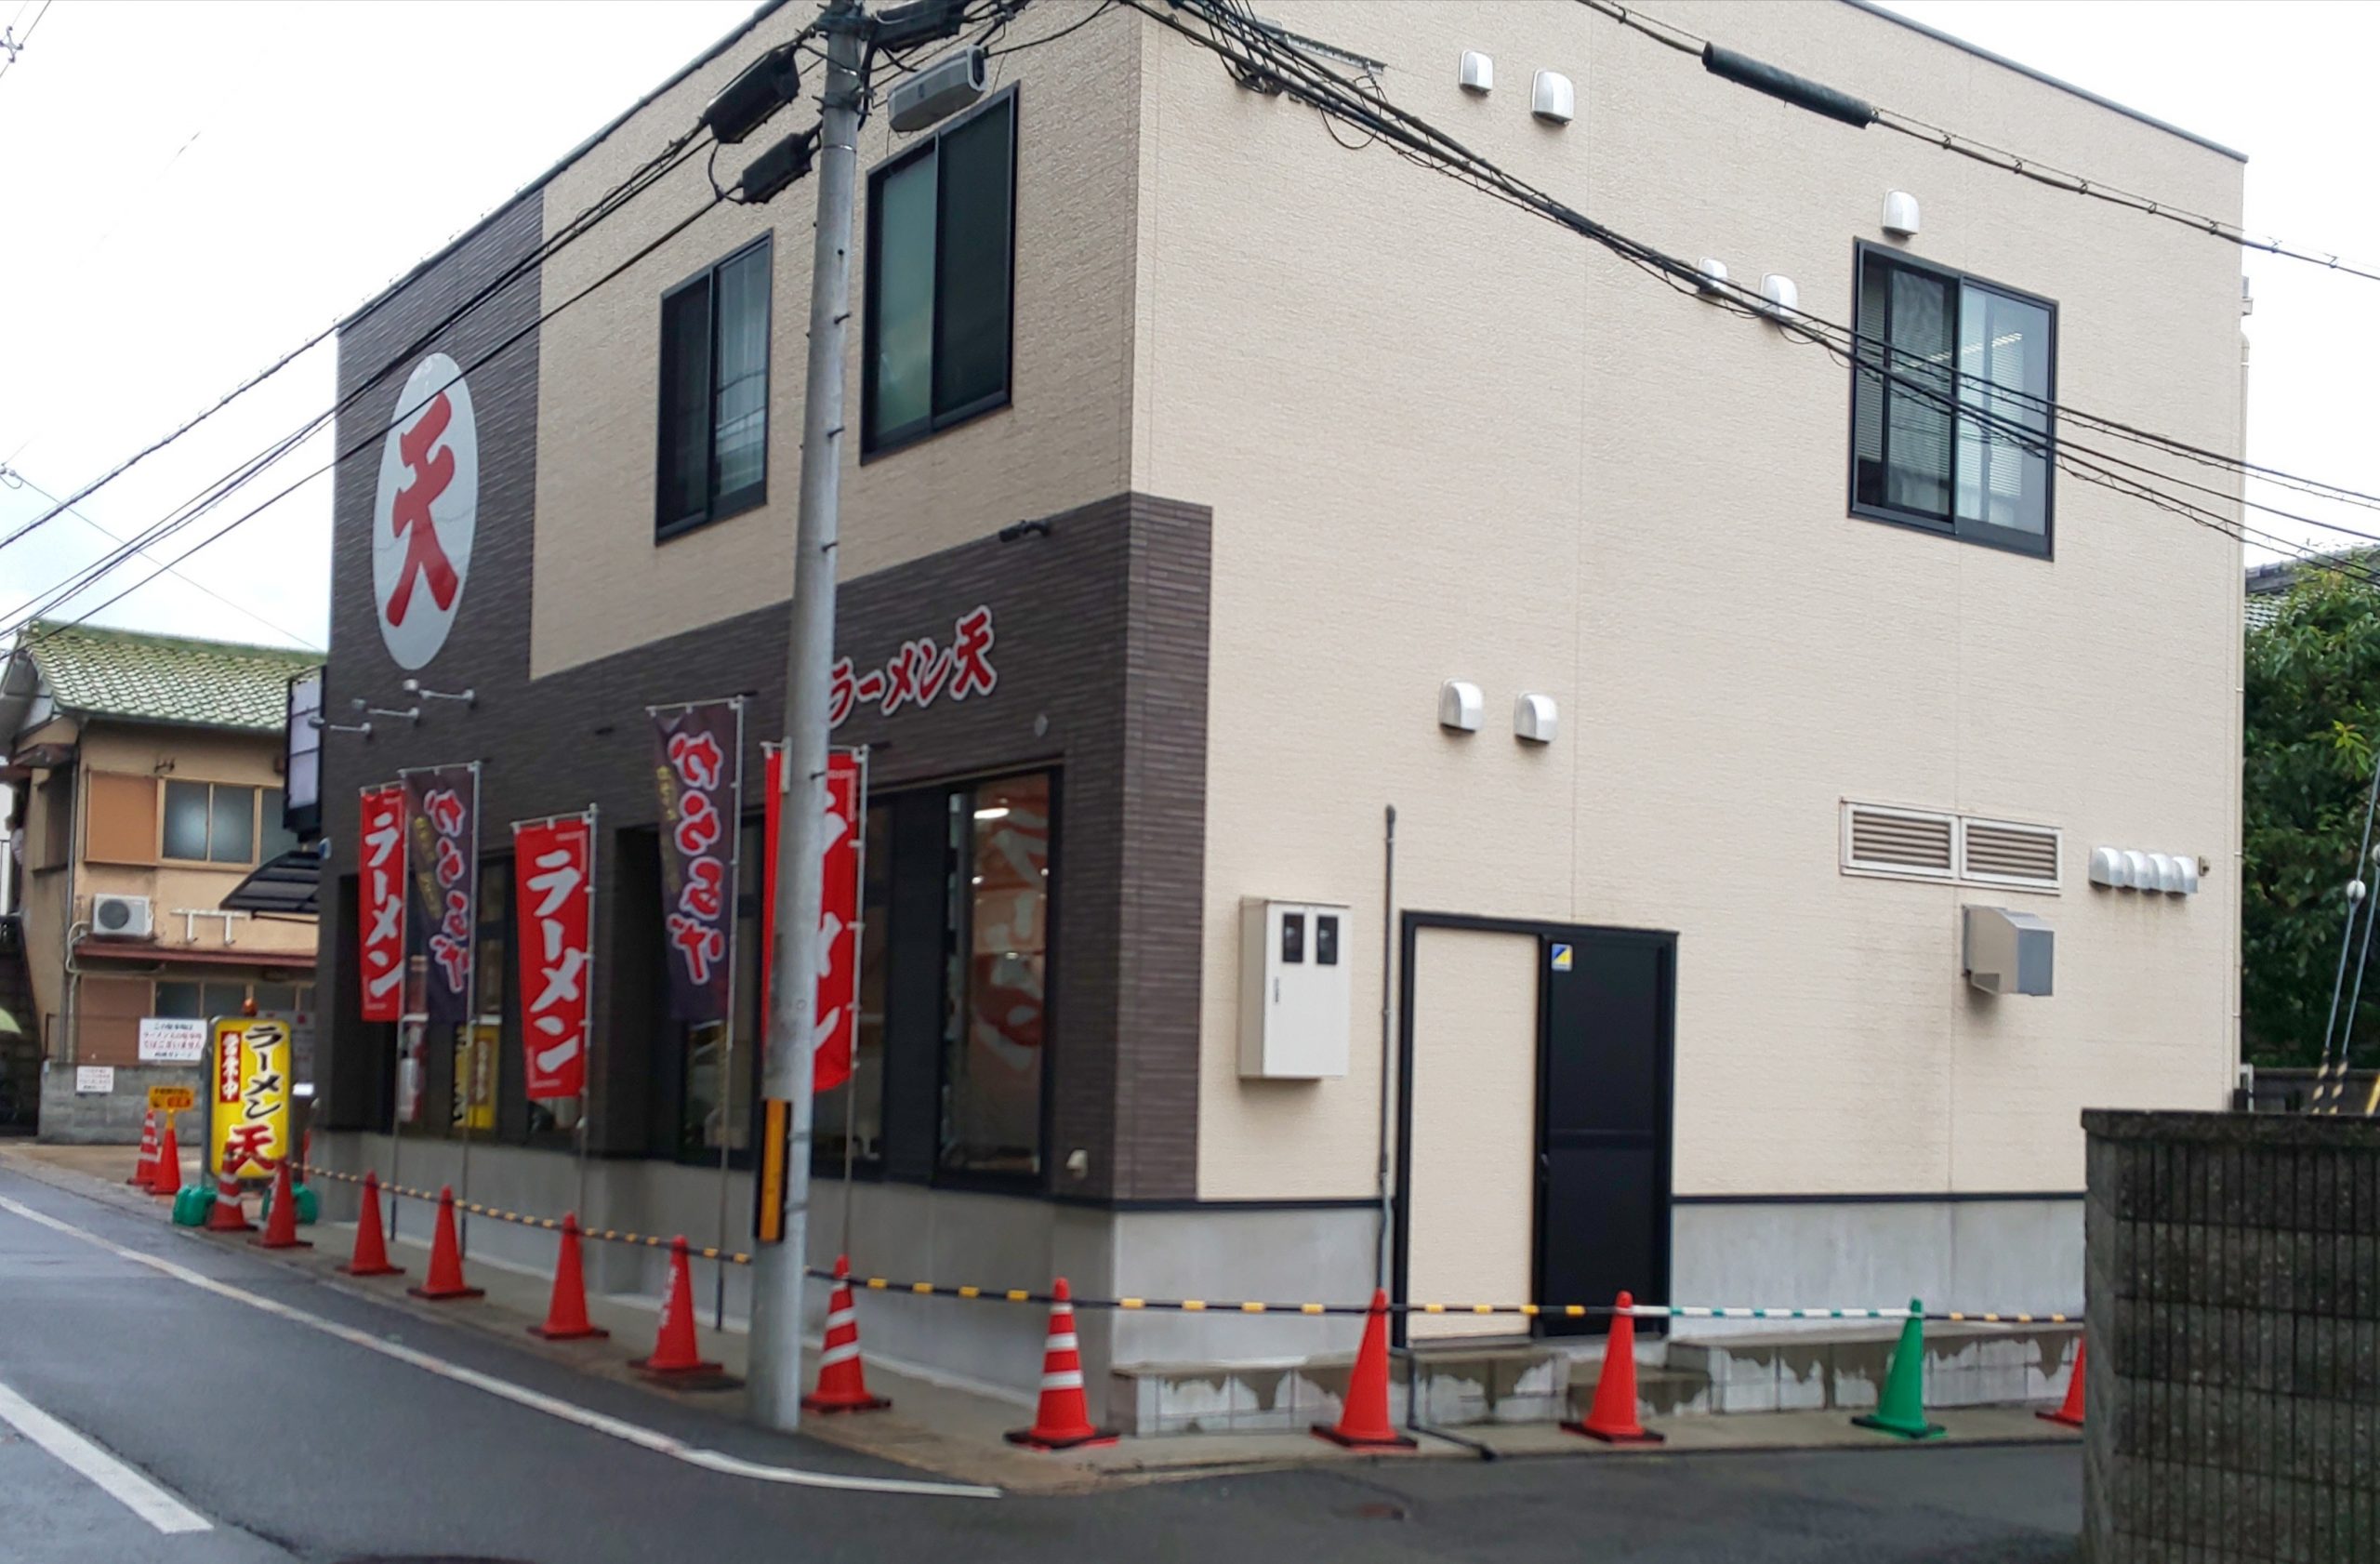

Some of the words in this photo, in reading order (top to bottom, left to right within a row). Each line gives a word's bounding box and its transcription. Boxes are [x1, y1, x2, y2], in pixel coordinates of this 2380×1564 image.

[385, 391, 459, 628] 天
[829, 604, 998, 730] ラーメン天
[364, 811, 405, 999] ラーメン
[526, 849, 584, 1074] ラーメン
[230, 1026, 284, 1170] ラーメン天
